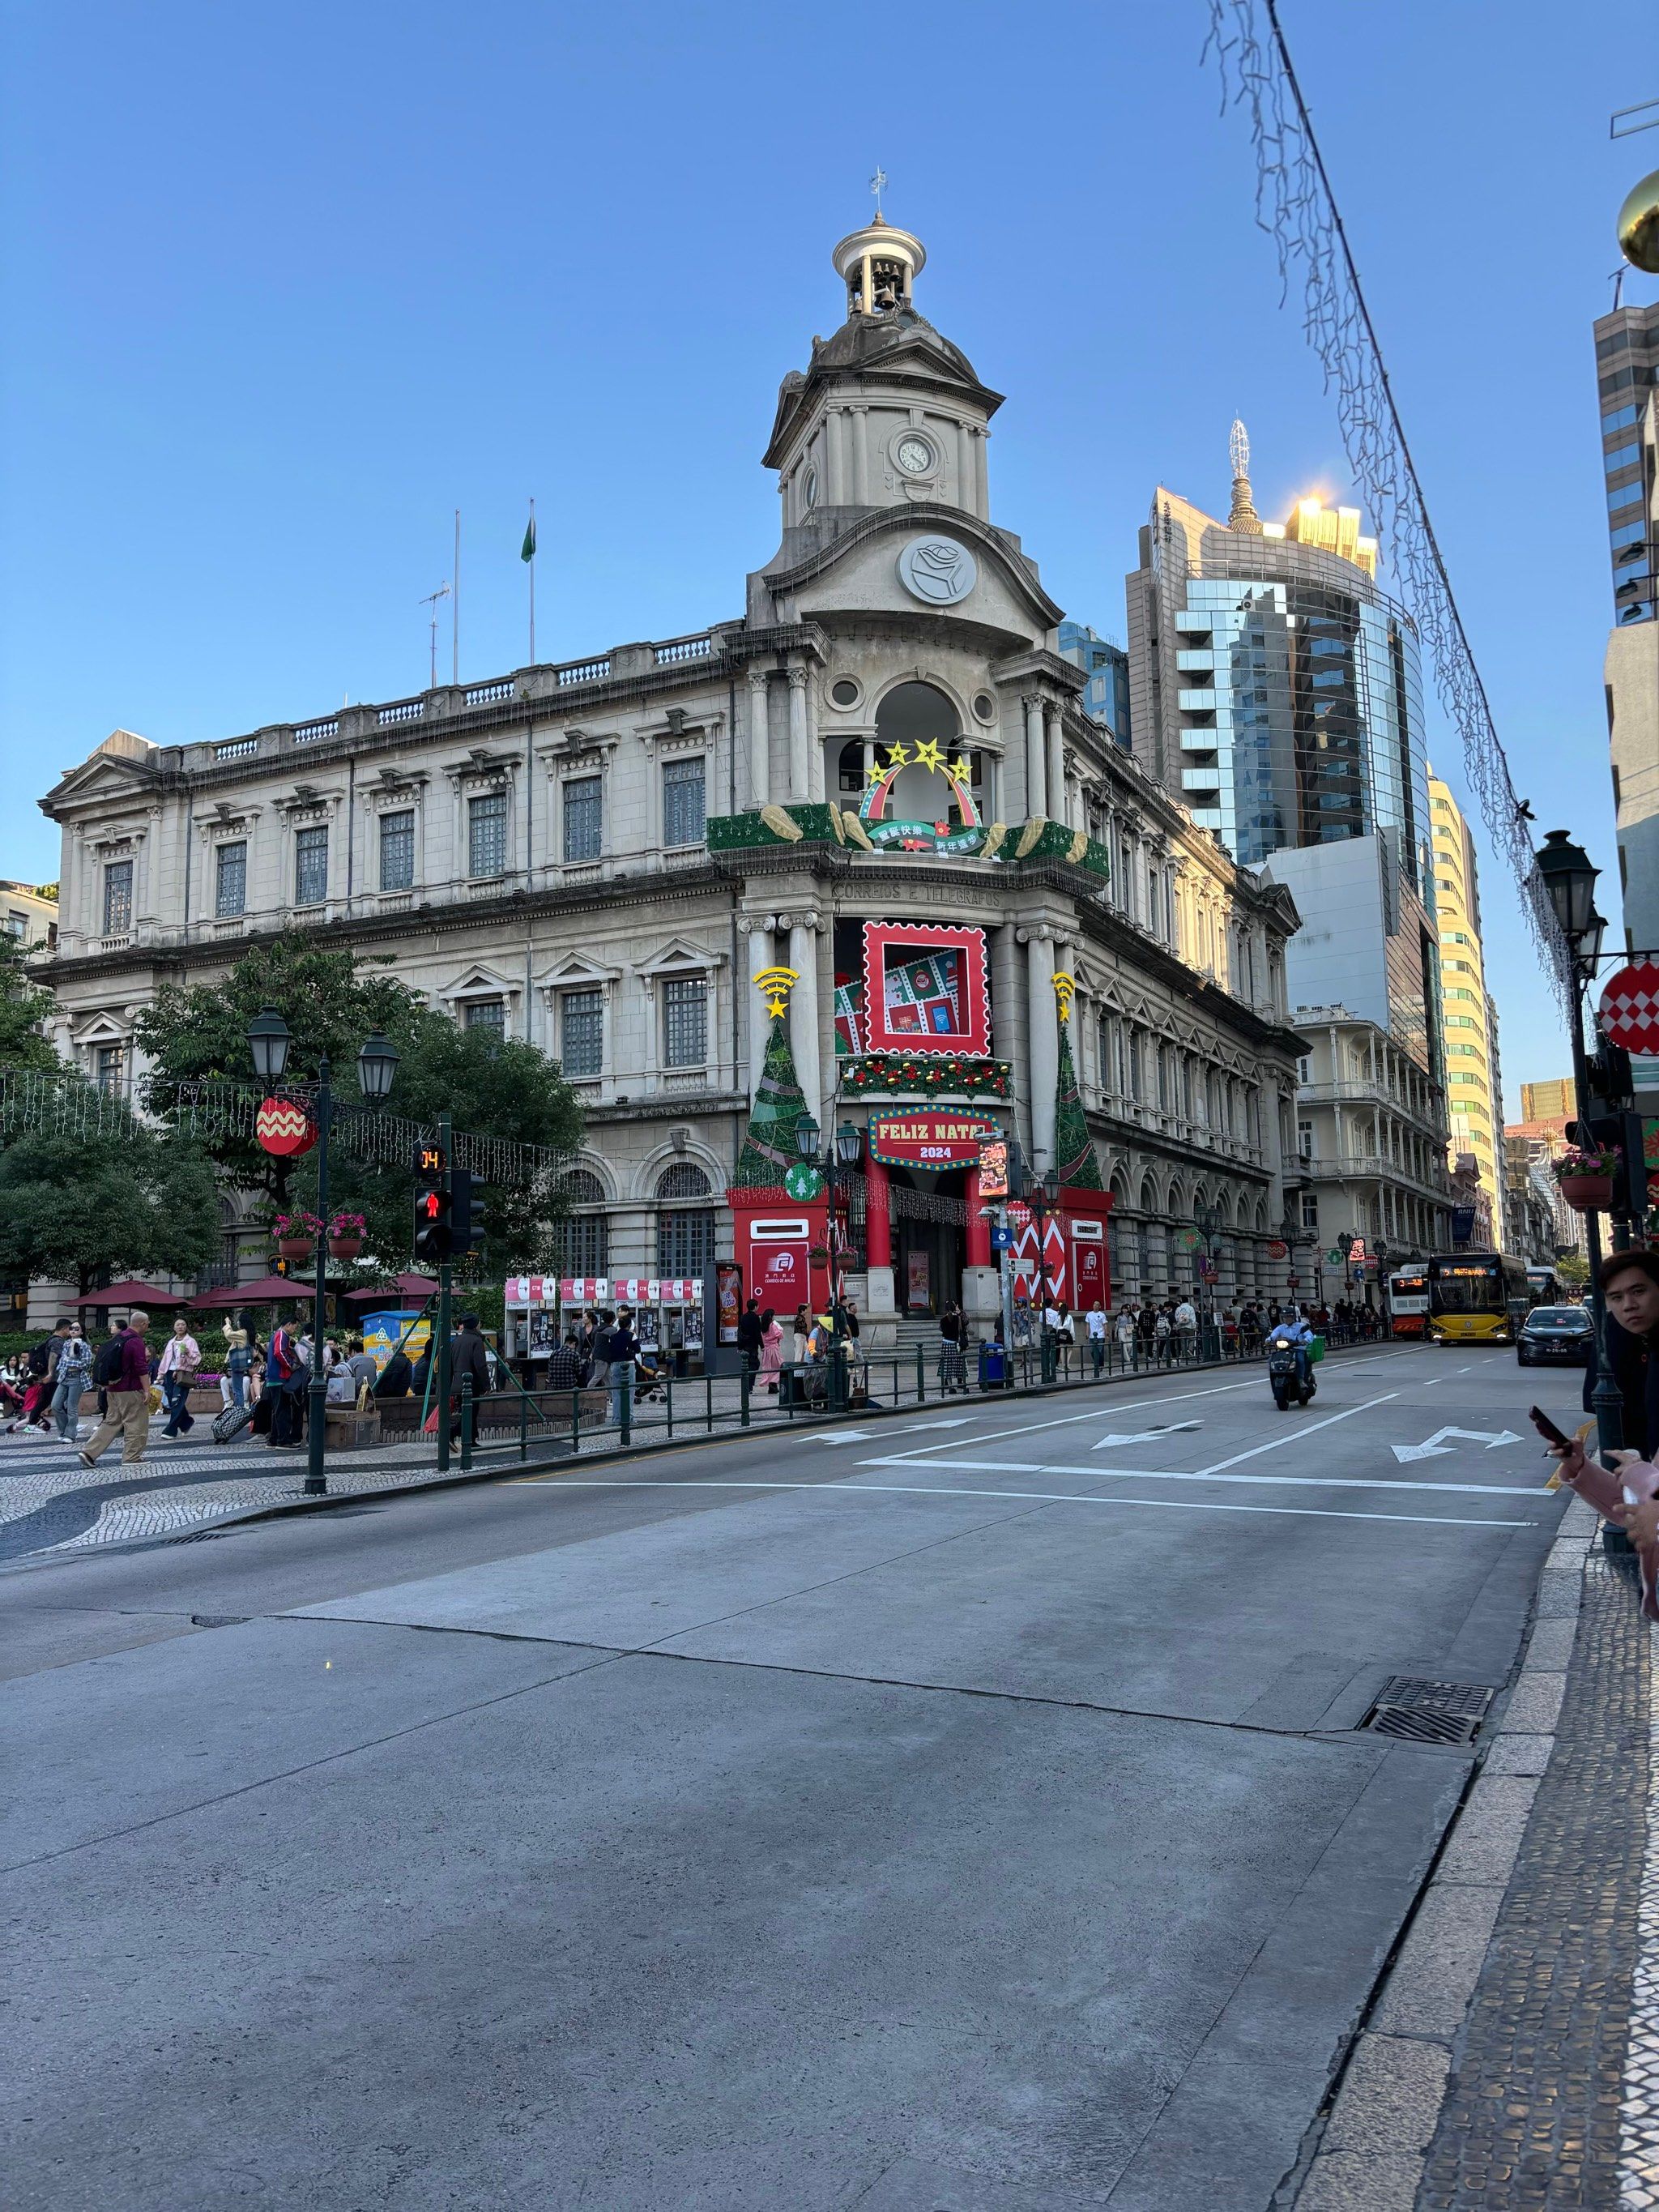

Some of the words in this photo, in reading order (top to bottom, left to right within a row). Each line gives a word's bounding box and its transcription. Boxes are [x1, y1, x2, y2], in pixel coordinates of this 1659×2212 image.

[878, 825, 923, 841] 聖誕快樂
[936, 835, 977, 851] 新年進步
[834, 883, 901, 899] CORREIOS
[909, 887, 918, 900] E
[926, 886, 1001, 906] TELEGRAFOS
[879, 1124, 929, 1140] FELIZ
[920, 1147, 951, 1158] 2024
